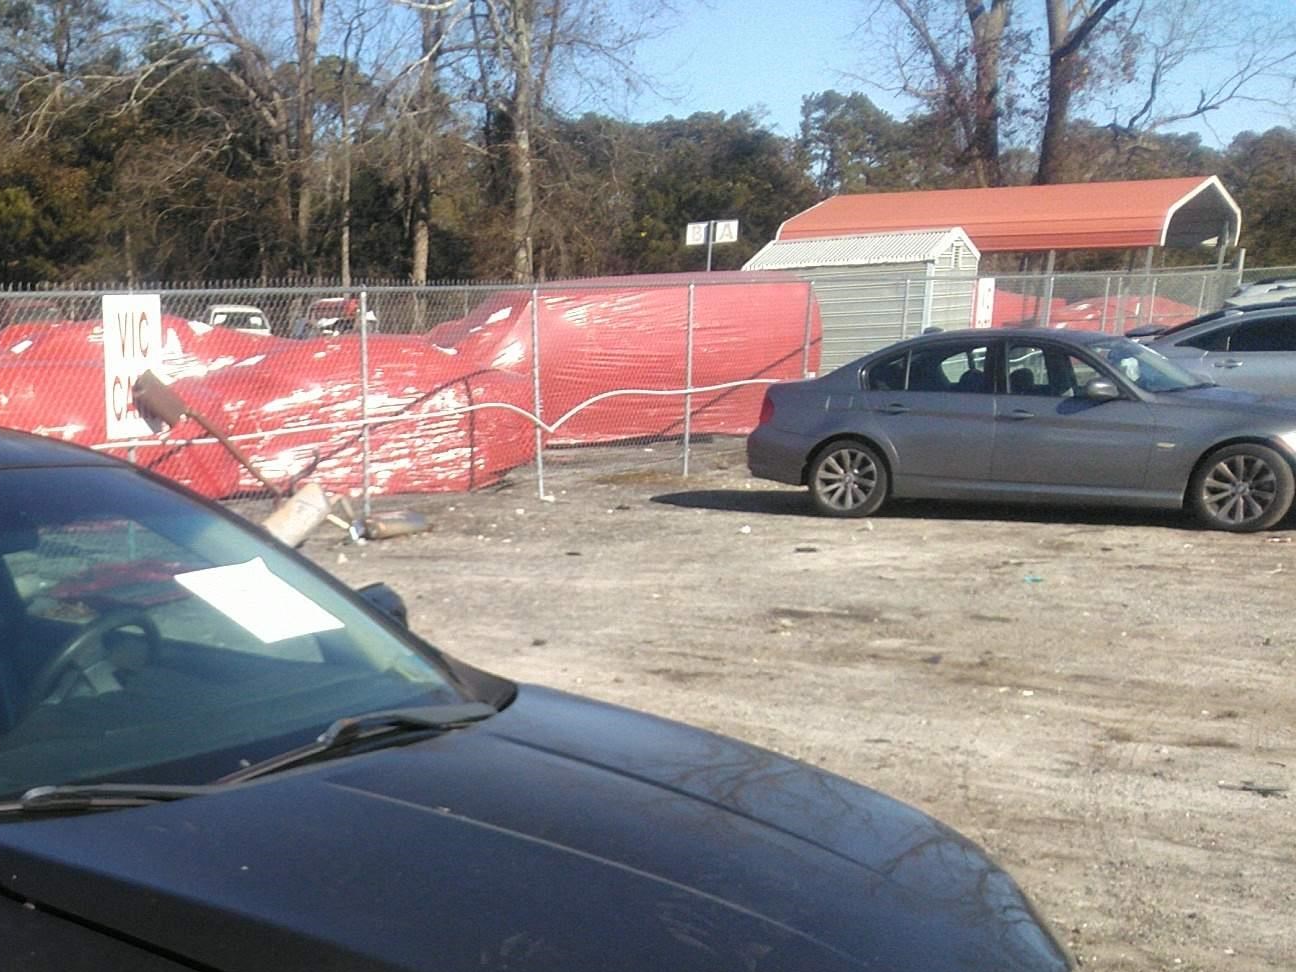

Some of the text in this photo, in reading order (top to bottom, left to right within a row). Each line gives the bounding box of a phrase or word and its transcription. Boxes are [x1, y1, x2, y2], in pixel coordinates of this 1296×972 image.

[691, 224, 702, 242] B
[718, 222, 734, 241] A
[117, 311, 150, 358] VIC
[112, 375, 140, 421] CA
